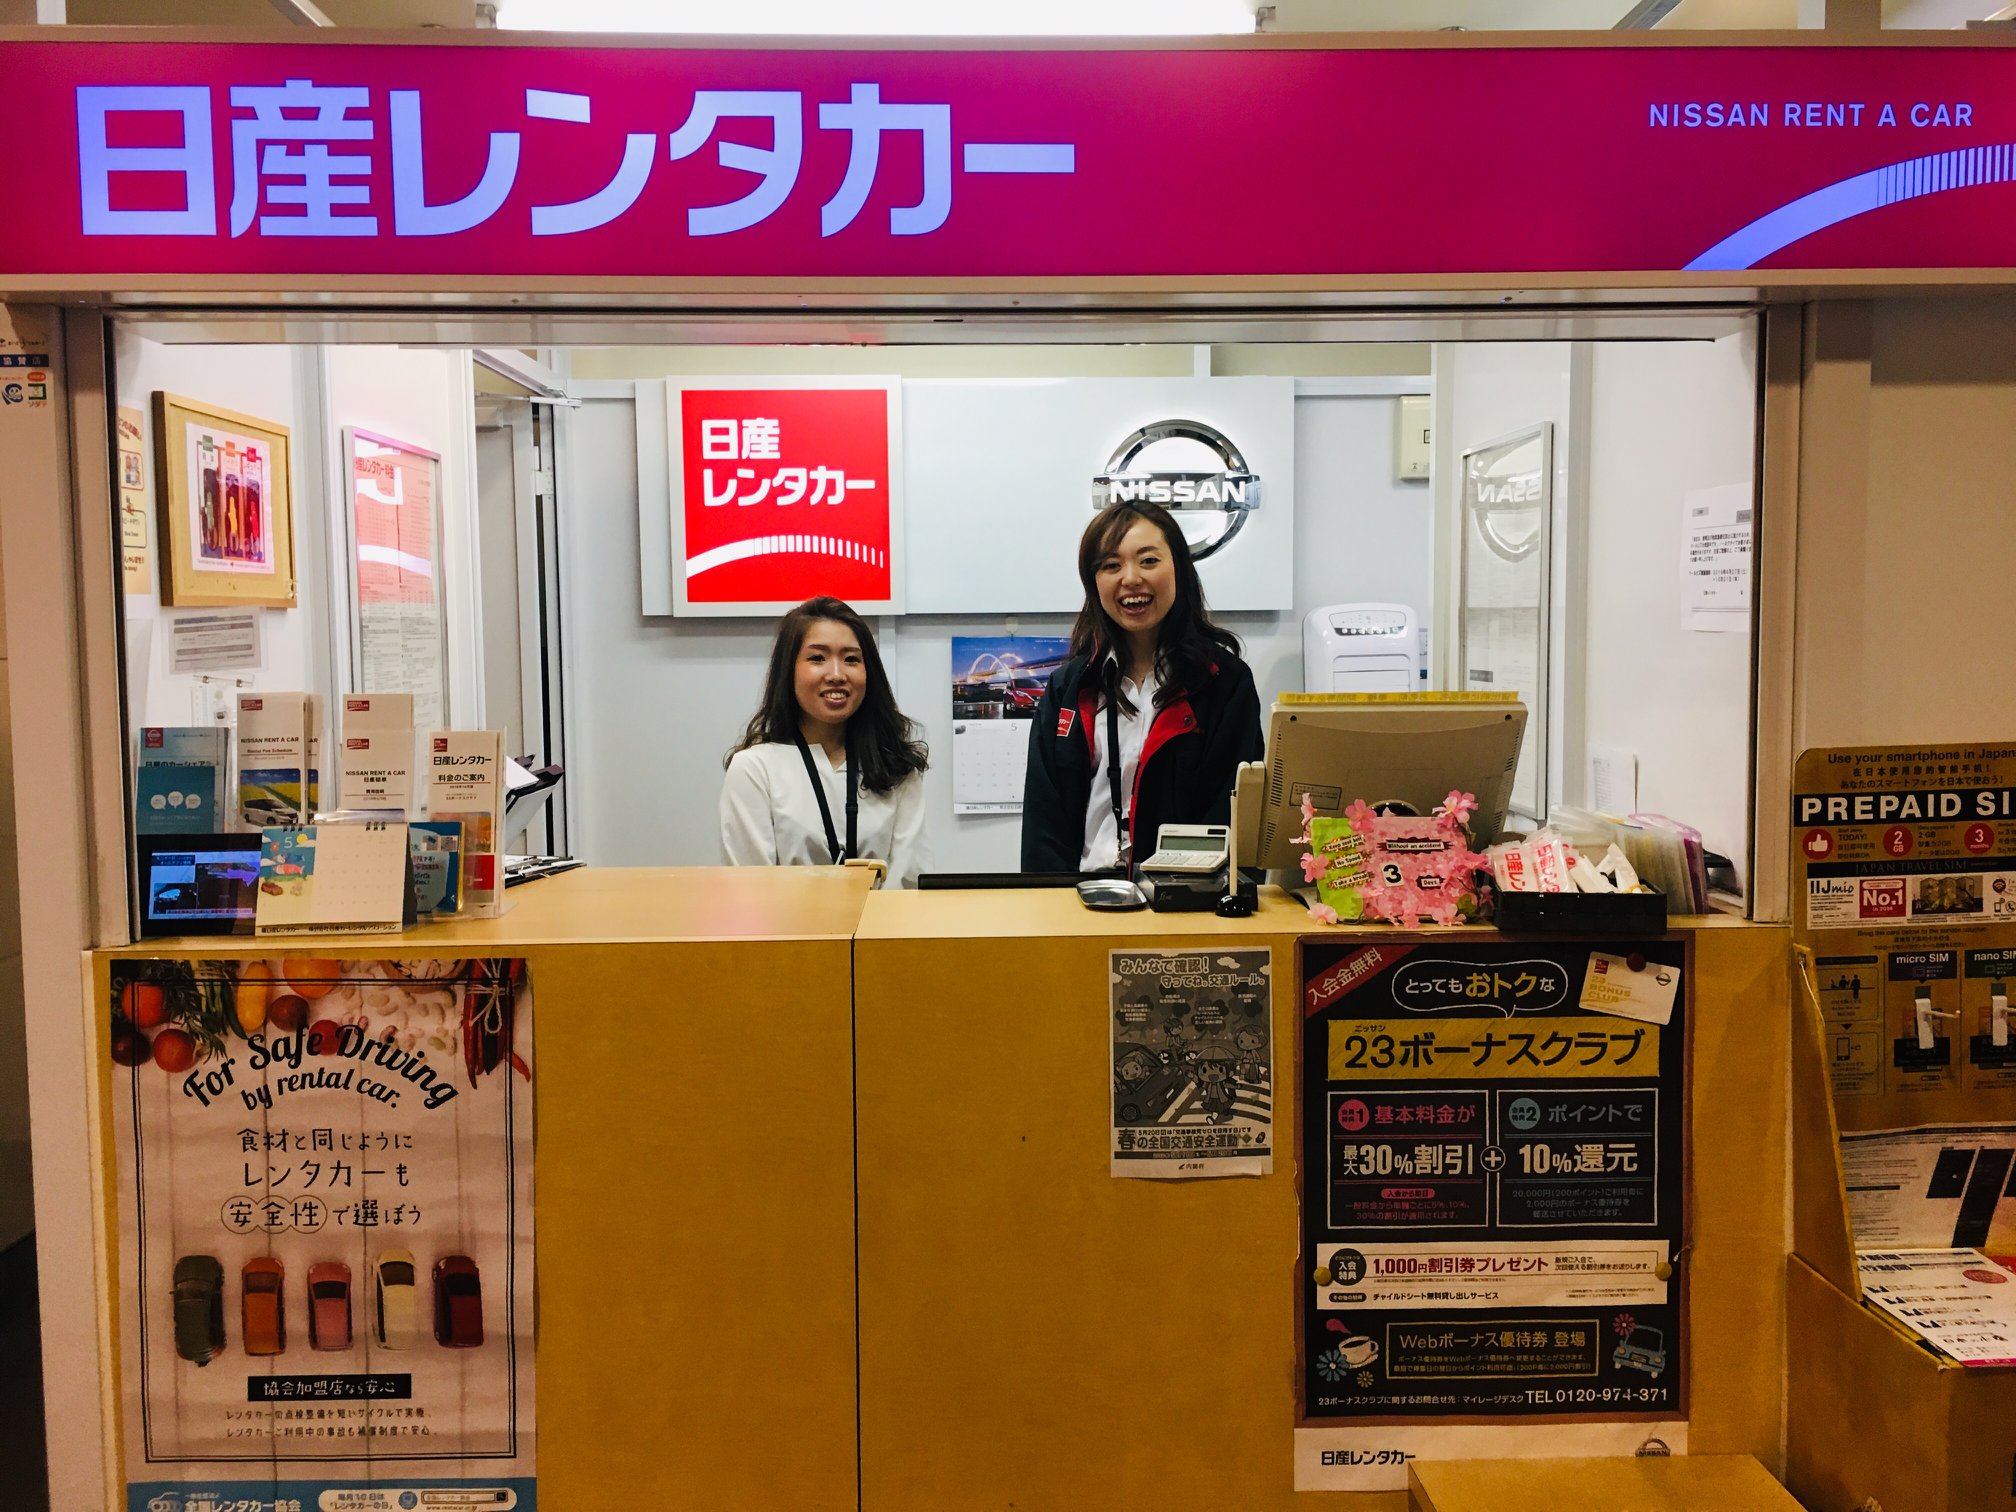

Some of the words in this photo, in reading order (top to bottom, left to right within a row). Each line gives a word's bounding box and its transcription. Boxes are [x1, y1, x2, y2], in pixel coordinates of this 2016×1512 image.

[1649, 103, 1769, 127] NISSAN
[1784, 103, 1865, 127] RENT
[1878, 103, 1897, 127] A
[1910, 103, 1973, 127] CAR
[75, 79, 1076, 239] 日産レンタカー
[702, 417, 781, 460] 日産
[703, 466, 875, 507] レンタカー
[1110, 480, 1245, 503] NISSAN
[1010, 722, 1018, 731] 5
[433, 756, 492, 766] 日産レンタカー
[1828, 753, 1851, 764] Use
[1856, 752, 1882, 766] your
[1886, 750, 1960, 765] smartphone
[1964, 749, 1975, 759] in
[438, 774, 485, 782] 料金のご案内
[1802, 793, 1962, 822] PREPAID
[284, 836, 293, 848] 5
[1838, 833, 1867, 841] TODAY!
[1894, 831, 1903, 845] 2
[1975, 828, 1984, 843] 3
[1893, 845, 1904, 853] GB
[1383, 864, 1402, 884] 3
[1856, 863, 1895, 875] JAPAN
[1900, 861, 1943, 873] TRAVEL
[1945, 860, 1967, 871] SIM
[1334, 879, 1347, 887] Take
[1810, 880, 1854, 894] IIJmio
[1863, 889, 1903, 907] No.1
[1896, 954, 1927, 964] micro
[1929, 953, 1949, 963] SIM
[1974, 951, 2000, 961] nano
[1120, 957, 1210, 974] みんなで確認！
[1161, 973, 1266, 988] 守ってね。交通ルール。
[1307, 947, 1384, 1005] 入会金無料
[1405, 972, 1556, 998] とってもおトクな
[1589, 983, 1631, 998] BONUS
[1588, 991, 1619, 1003] CLUB
[1354, 1024, 1386, 1033] ニッサン
[1345, 1029, 1646, 1069] 23ボーナスクラブ
[183, 1058, 236, 1108] For
[248, 1024, 324, 1070] Safe
[335, 1024, 459, 1110] Driving
[241, 1082, 273, 1110] by
[277, 1067, 351, 1096] rental
[356, 1077, 401, 1108] car.
[1356, 1108, 1364, 1123] 1
[1374, 1104, 1475, 1124] 基本料金が
[1526, 1106, 1537, 1122] 2
[1548, 1104, 1643, 1123] ポイントで
[236, 1128, 413, 1153] 食材と同じように
[1118, 1129, 1238, 1151] 春の全国交通安全運動
[1343, 1144, 1473, 1175] 最大30%割引
[1519, 1143, 1638, 1174] 10%還元
[244, 1159, 410, 1188] レンタカーも
[229, 1200, 421, 1227] 安全性で選ぼう
[1338, 1261, 1357, 1271] 入会
[1373, 1256, 1549, 1276] 1,000円割引券プレゼント
[1338, 1270, 1357, 1281] 特典
[1373, 1291, 1499, 1301] チャイルドシート無料貸し出しサービス
[1400, 1331, 1548, 1349] Webボーナス優待券
[1554, 1331, 1586, 1348] 登場
[264, 1380, 395, 1396] 協会加盟店なら安心
[1525, 1390, 1553, 1404] TEL
[1556, 1388, 1668, 1403] 0120-974-371
[1320, 1449, 1416, 1466] 日産レンタカー
